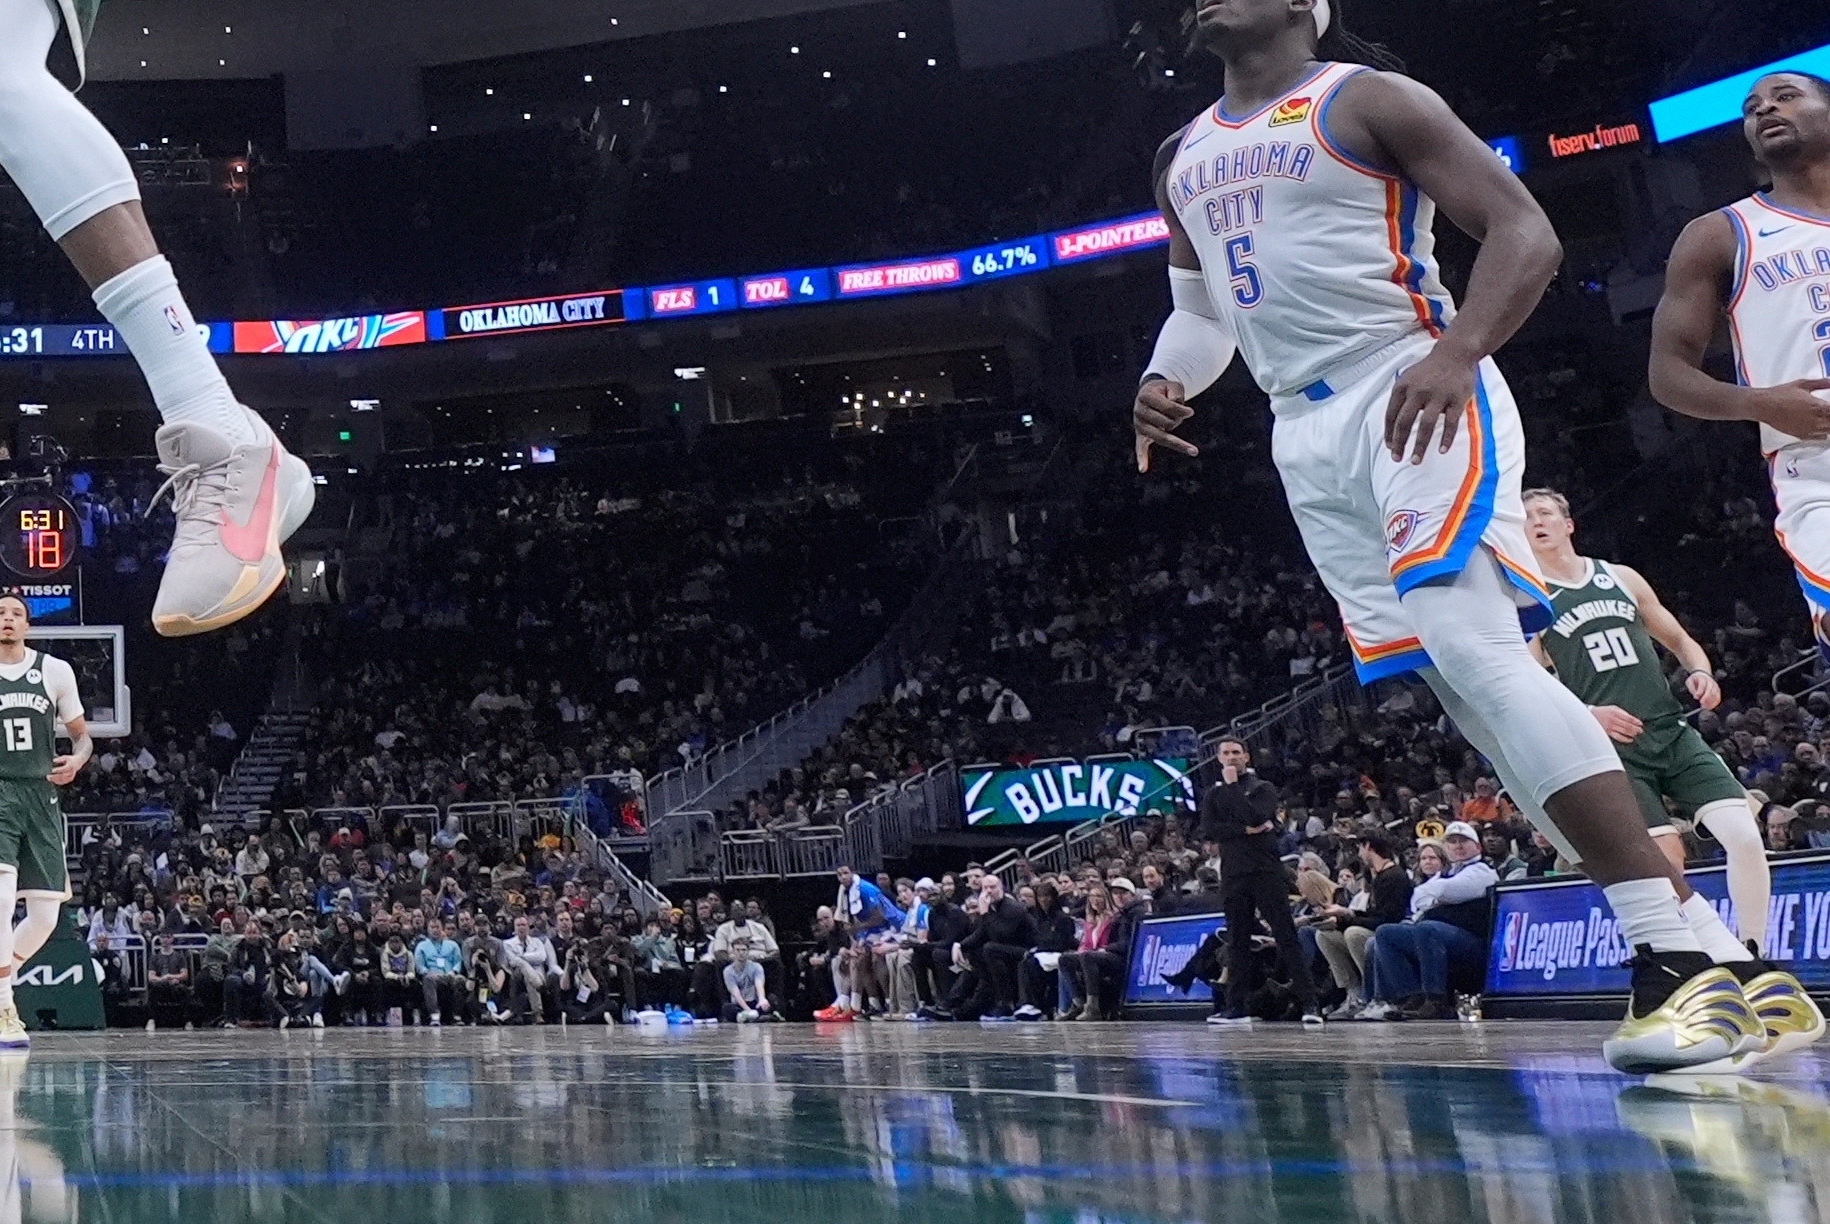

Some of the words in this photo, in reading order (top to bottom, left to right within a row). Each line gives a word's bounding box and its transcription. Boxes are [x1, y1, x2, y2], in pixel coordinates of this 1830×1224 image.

[1170, 141, 1315, 216] OKLAHOMA
[1204, 185, 1263, 236] CITY
[1059, 216, 1170, 257] 3-POINTERS
[745, 281, 788, 301] TOL
[799, 276, 815, 296] 4
[842, 267, 884, 292] FREE
[886, 261, 958, 286] THROWS
[971, 245, 1037, 276] 66.7%
[1223, 230, 1265, 308] 5
[459, 306, 561, 333] OKLAHOMA
[562, 296, 606, 322] CITY
[655, 289, 694, 311] FLS
[708, 286, 719, 307] 1
[71, 329, 114, 351] 4TH
[20, 510, 64, 531] 6:31
[28, 531, 61, 568] 18
[21, 584, 72, 596] TISSOT
[1553, 599, 1636, 639] MILWAUKEE
[1582, 626, 1640, 673] 20
[2, 718, 33, 752] 13
[1005, 764, 1145, 824] BUCKS
[1515, 912, 1585, 981] League
